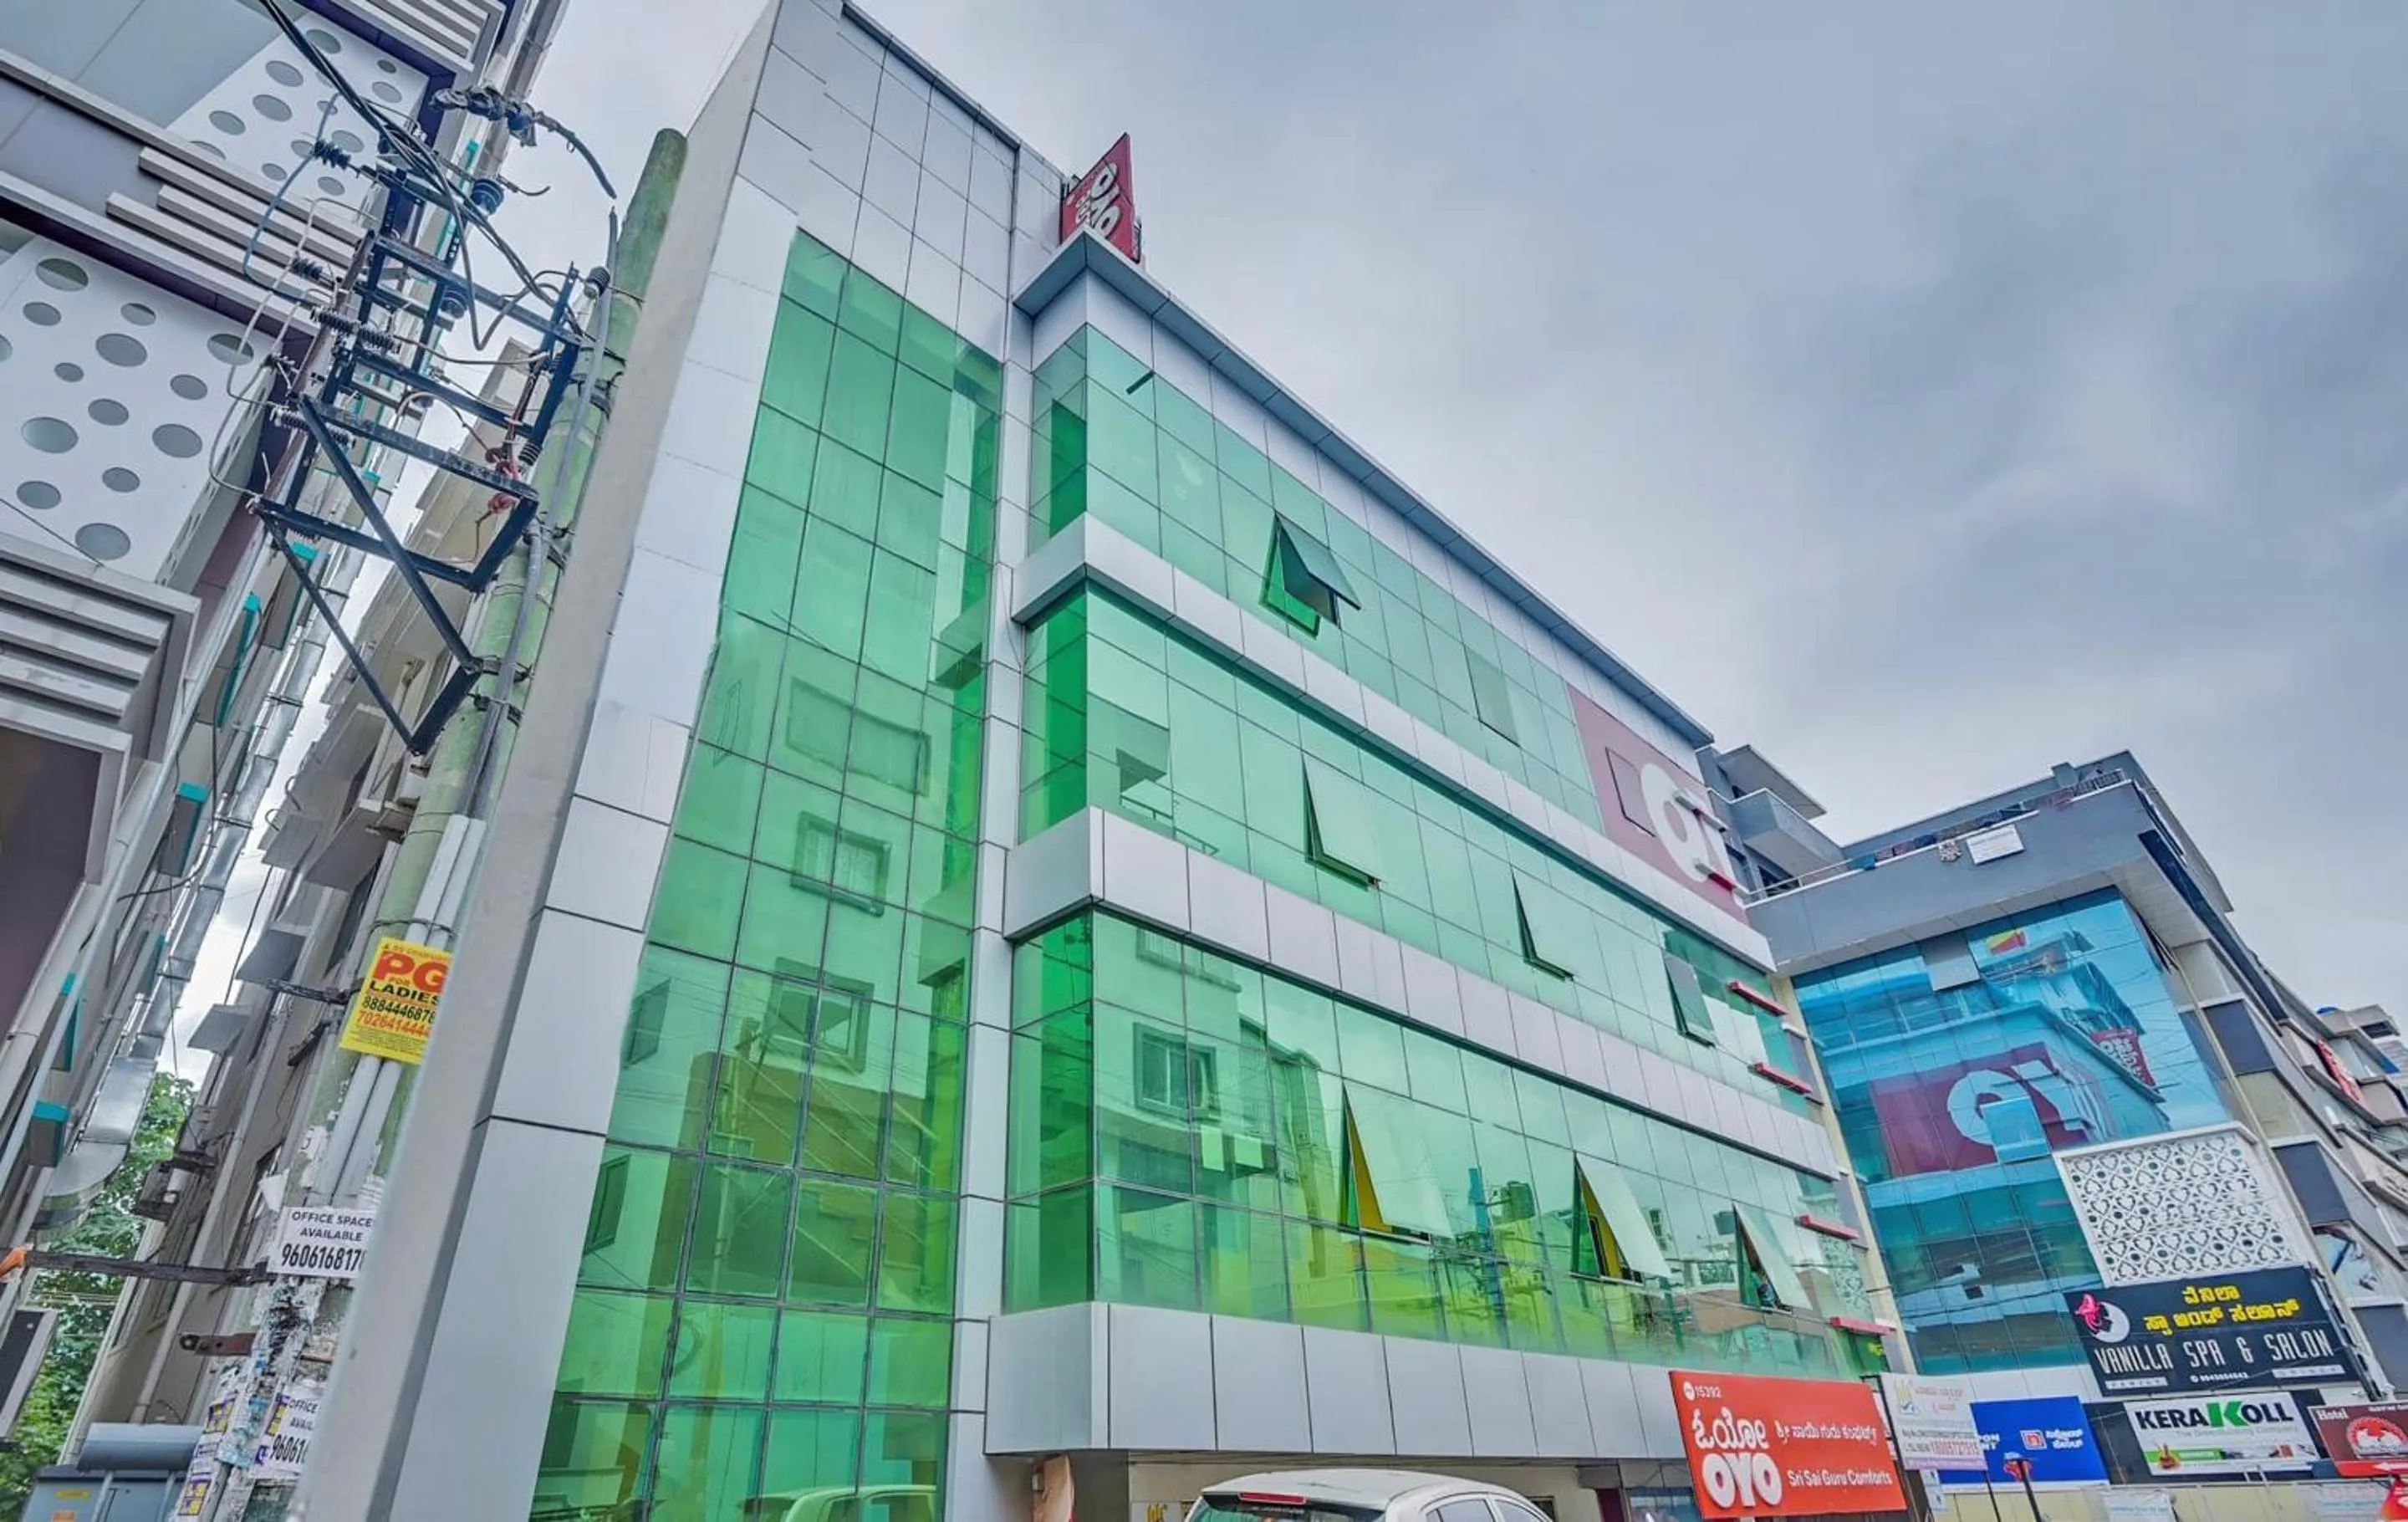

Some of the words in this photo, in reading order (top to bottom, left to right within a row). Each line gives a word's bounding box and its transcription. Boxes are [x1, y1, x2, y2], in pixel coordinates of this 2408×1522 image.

[372, 949, 449, 993] PG
[292, 1211, 334, 1224] OFFICE
[336, 1215, 374, 1228] SPACE
[299, 1227, 365, 1242] AVAILABLE
[2094, 1343, 2174, 1375] VANILLA
[2183, 1338, 2227, 1369] SPA
[2237, 1336, 2254, 1364] &
[2264, 1329, 2335, 1362] SALON
[289, 1399, 319, 1413] OFFICE
[2135, 1401, 2295, 1430] KERAKOLL
[2315, 1408, 2349, 1421] Hotel
[1701, 1453, 1783, 1509] OYO
[1787, 1469, 1804, 1487] Sri
[1804, 1469, 1823, 1487] Sai
[1822, 1468, 1848, 1486] Guru
[1847, 1468, 1893, 1486] Comforts
